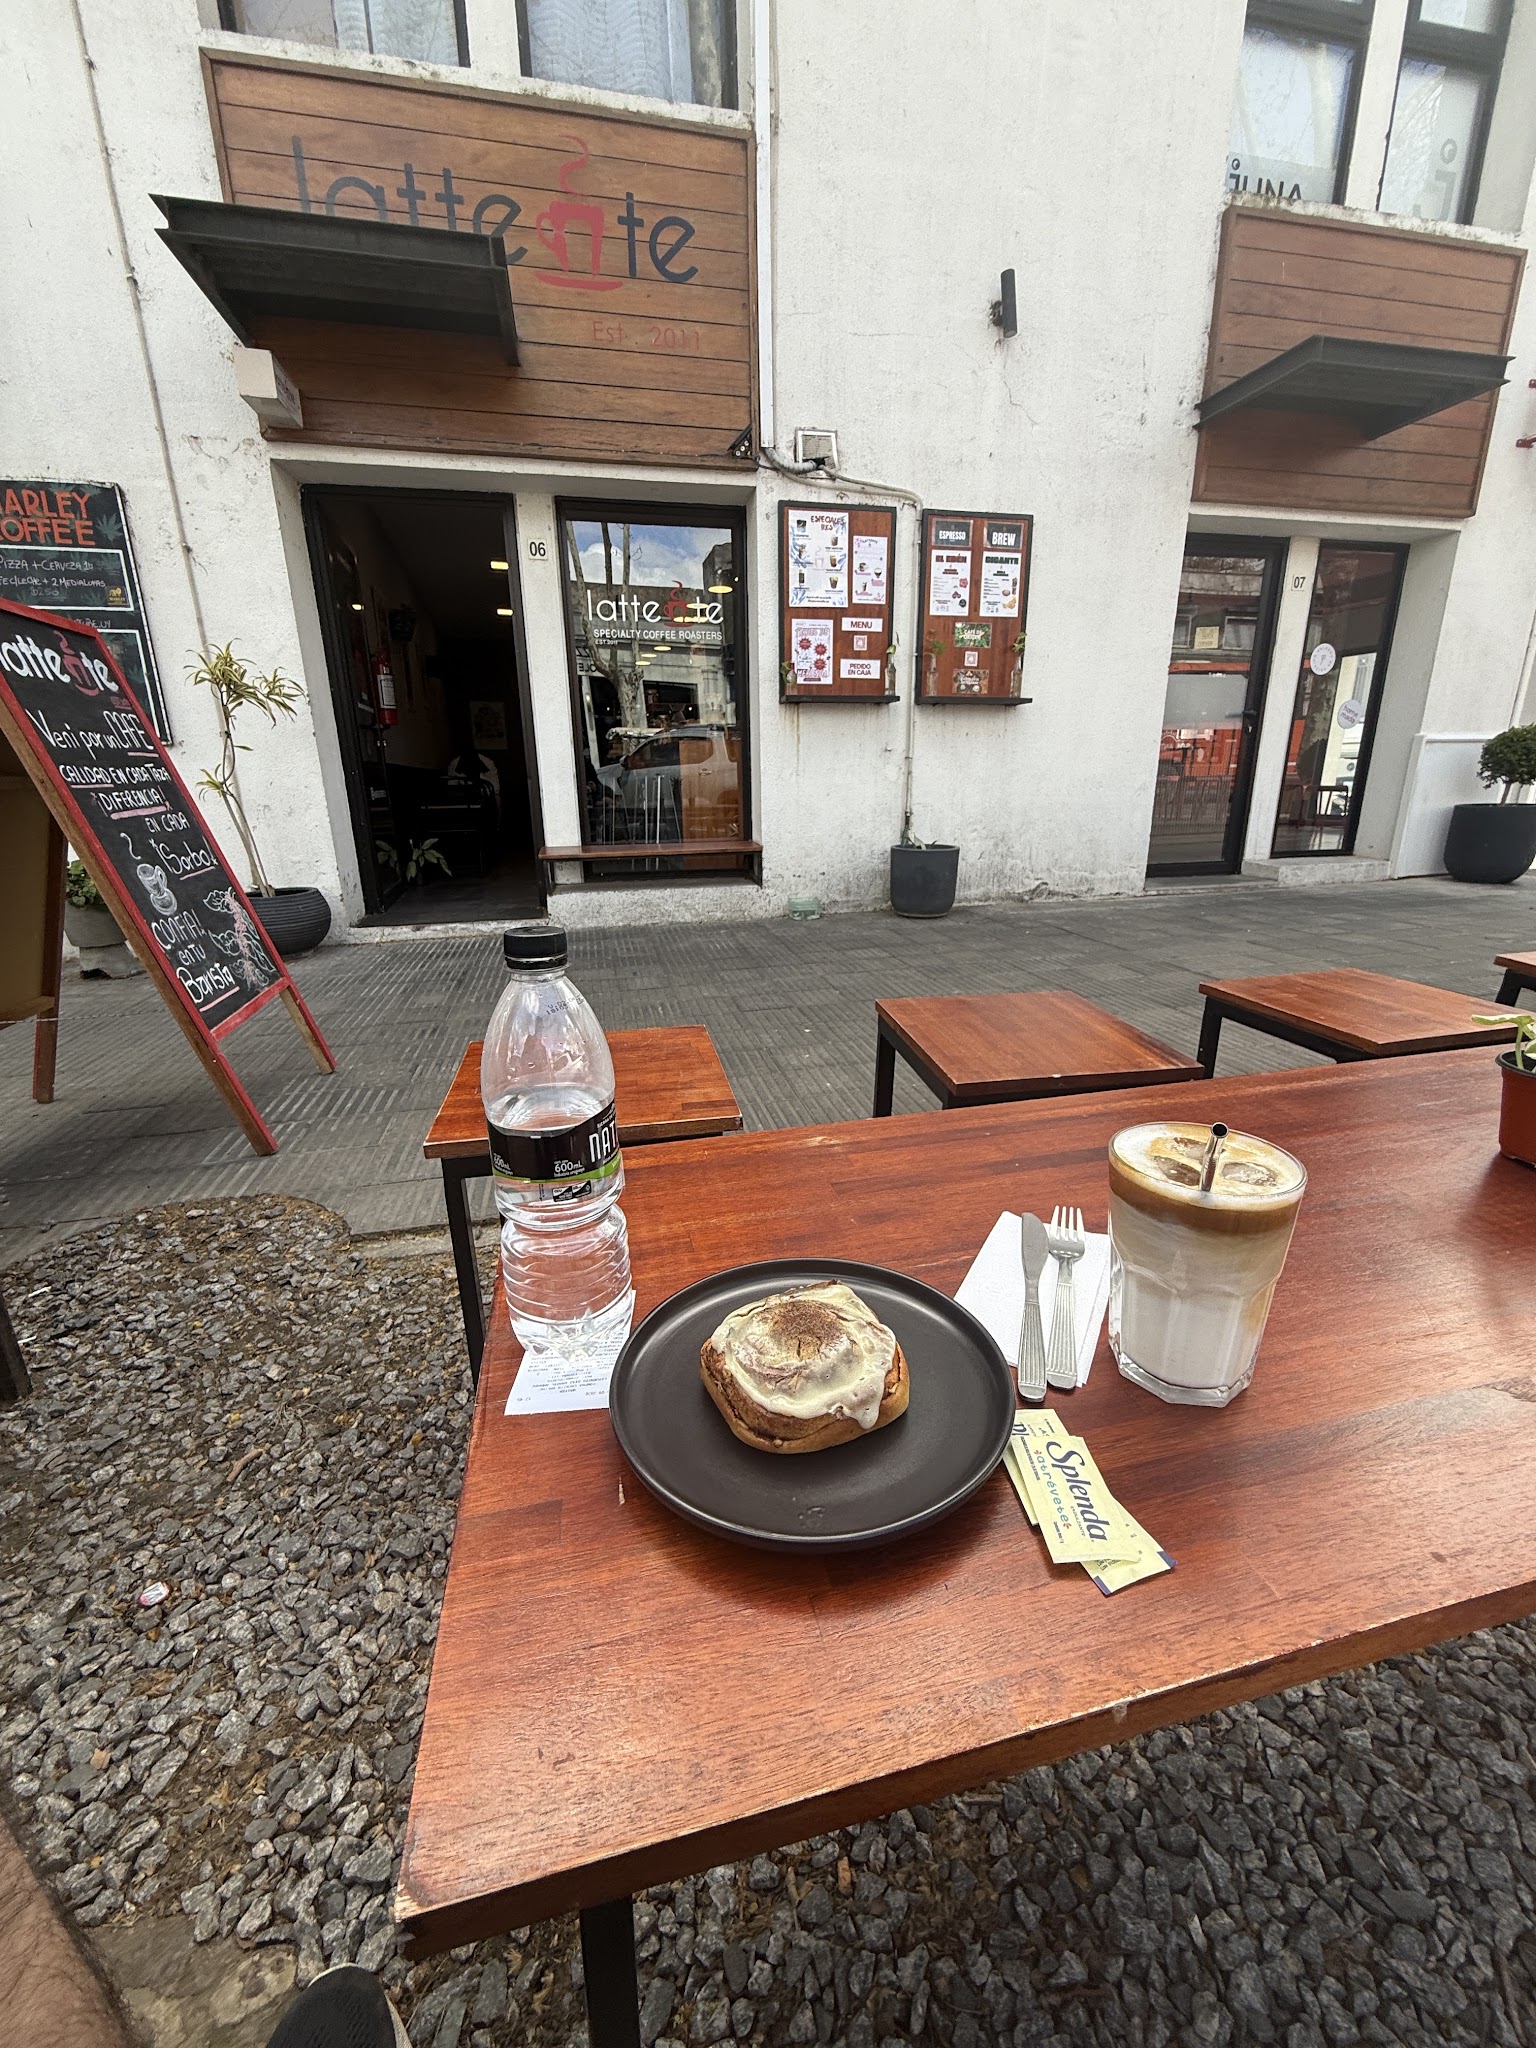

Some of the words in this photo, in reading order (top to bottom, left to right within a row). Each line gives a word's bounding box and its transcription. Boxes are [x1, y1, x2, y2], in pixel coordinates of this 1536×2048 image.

[649, 326, 700, 353] 2011
[0, 488, 90, 519] ARLEY
[0, 517, 96, 546] OFFEE
[939, 530, 966, 540] ESPRESSO
[991, 531, 1016, 546] BREW
[529, 541, 546, 557] 06
[1293, 576, 1306, 589] 07
[593, 628, 641, 639] SPECIALTY
[643, 629, 677, 640] COFFEE
[678, 630, 723, 641] ROASTERS
[850, 620, 873, 629] MENU
[79, 730, 105, 760] por
[59, 764, 112, 784] CALIDAD
[108, 767, 129, 784] EN
[125, 766, 152, 784] CADA
[144, 817, 161, 833] EN
[161, 811, 191, 832] CADA
[1037, 1455, 1069, 1523] atrévete
[1045, 1441, 1110, 1541] Splenda
